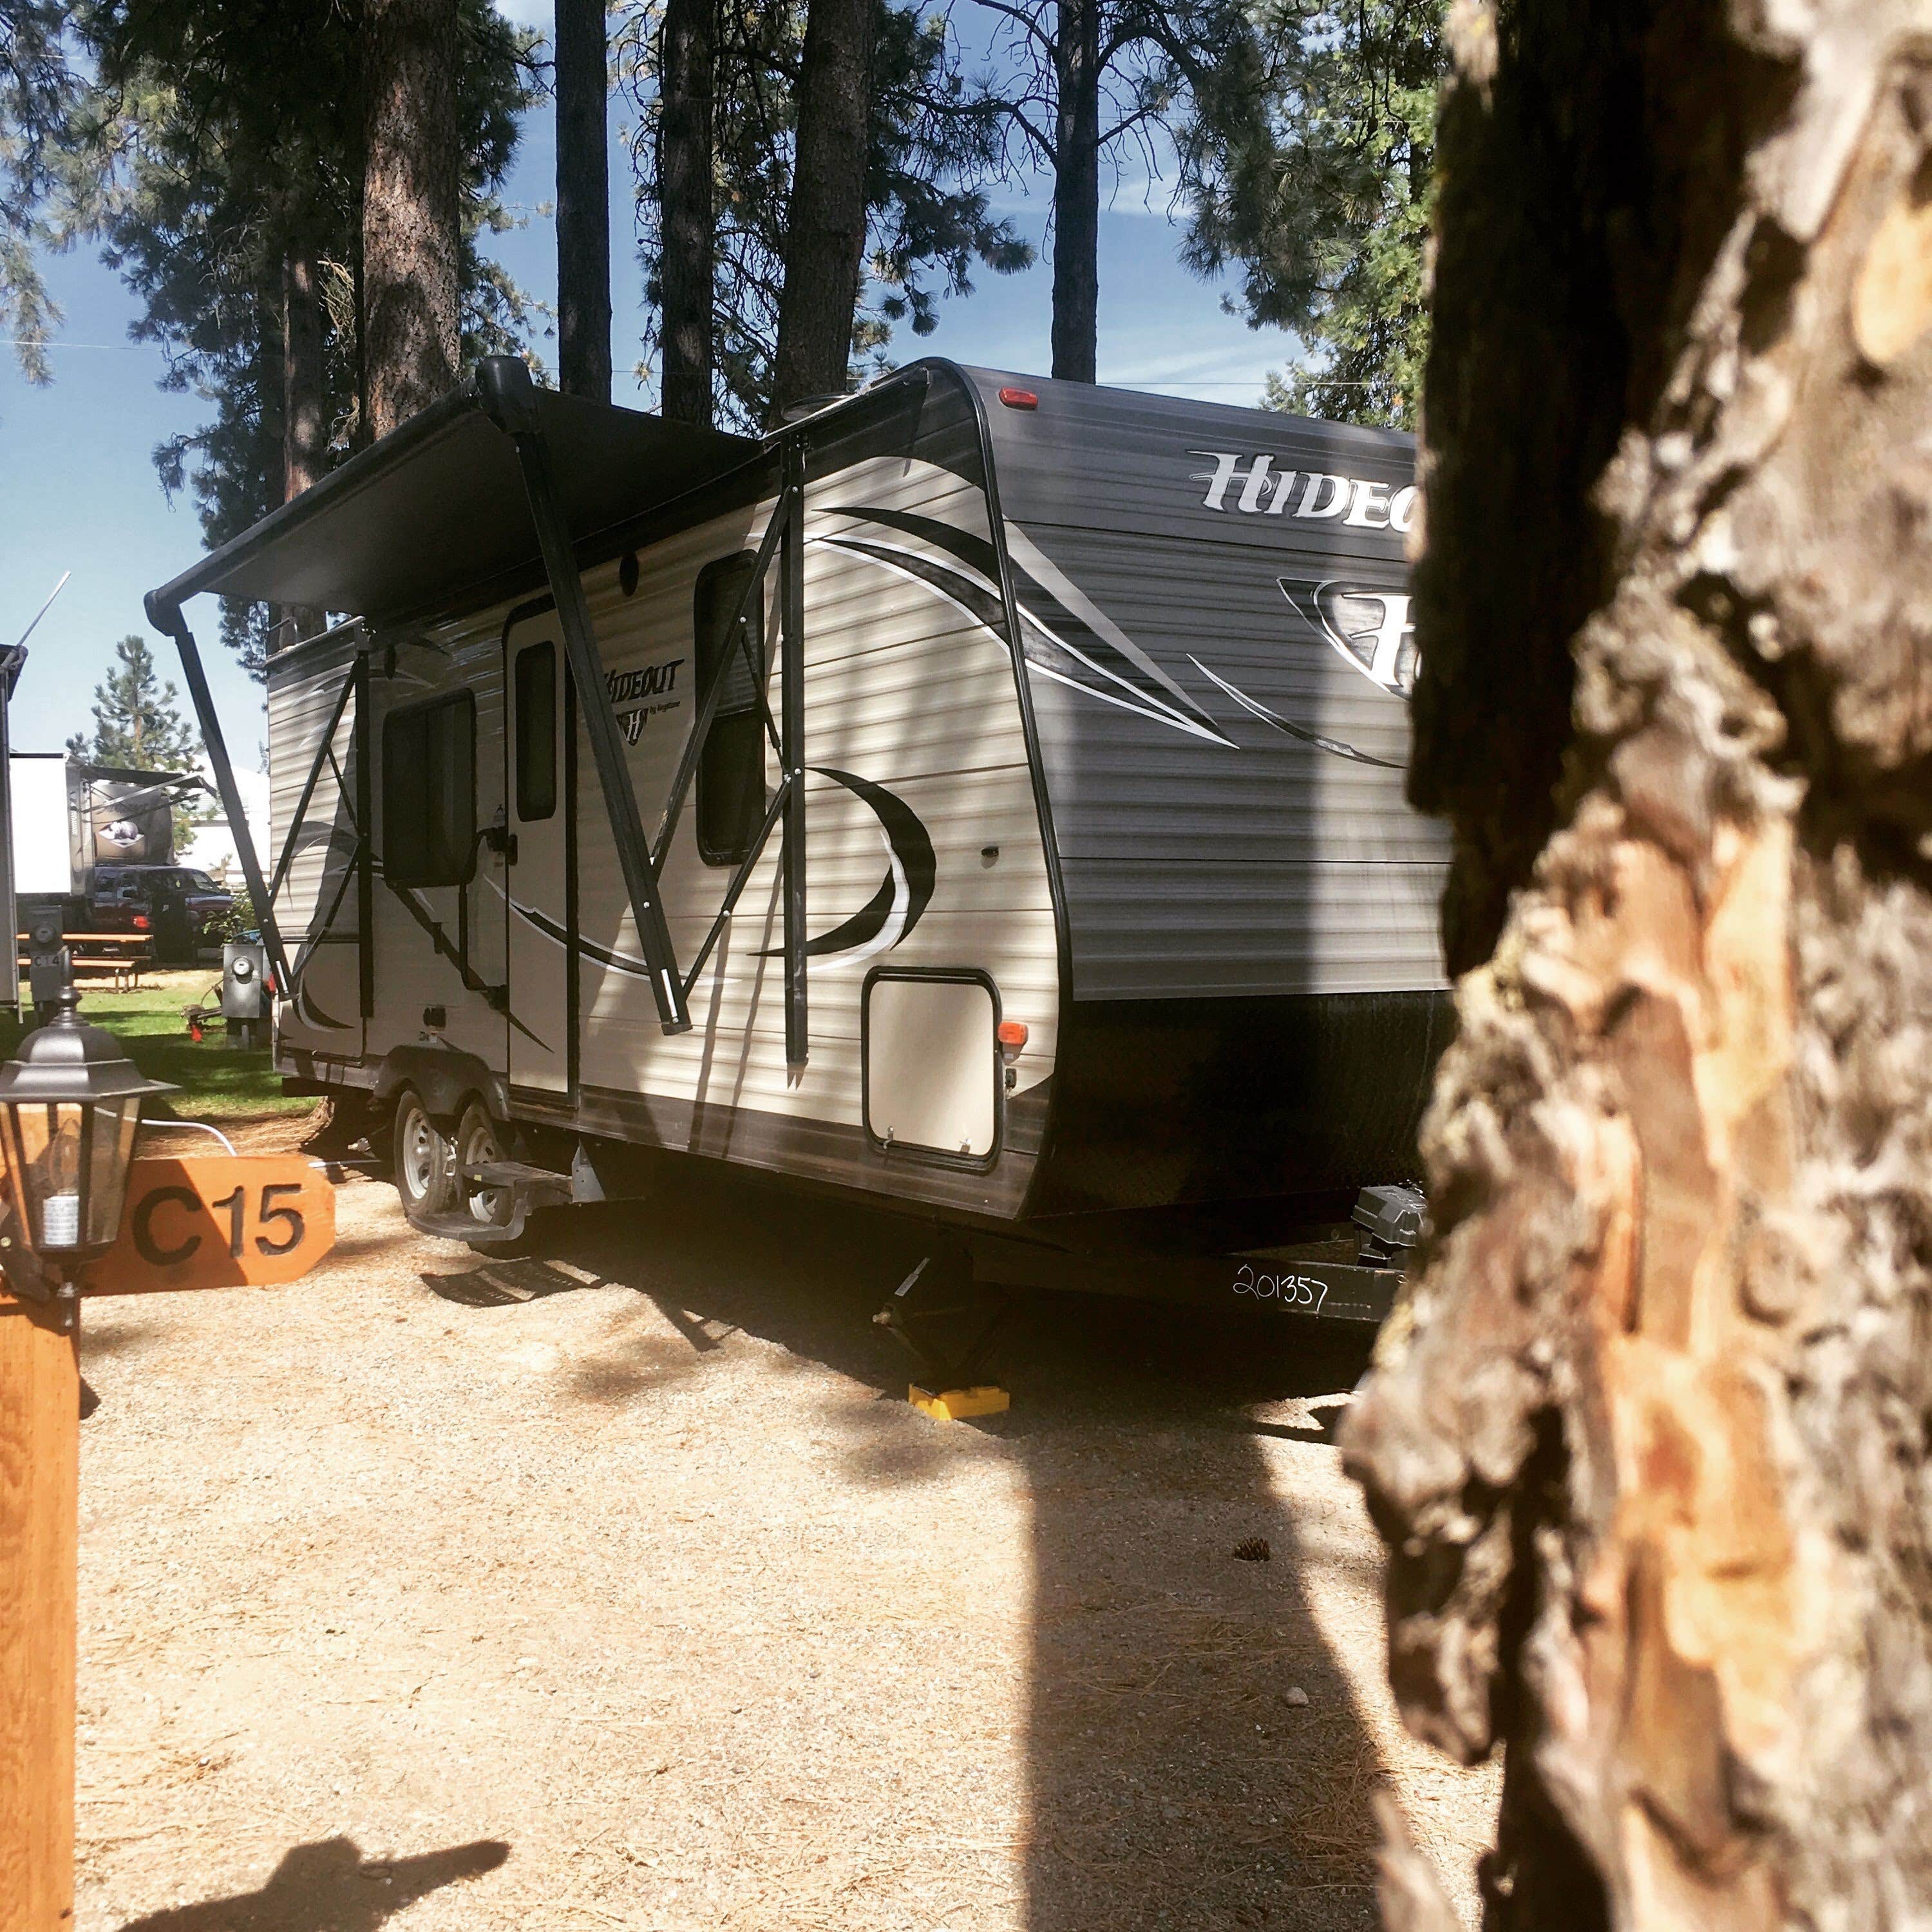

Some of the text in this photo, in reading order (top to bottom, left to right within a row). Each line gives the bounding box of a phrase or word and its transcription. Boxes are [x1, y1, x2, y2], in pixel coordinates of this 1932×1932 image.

[34, 956, 60, 966] C14
[133, 1183, 305, 1266] C15
[1233, 1264, 1328, 1312] 201357
